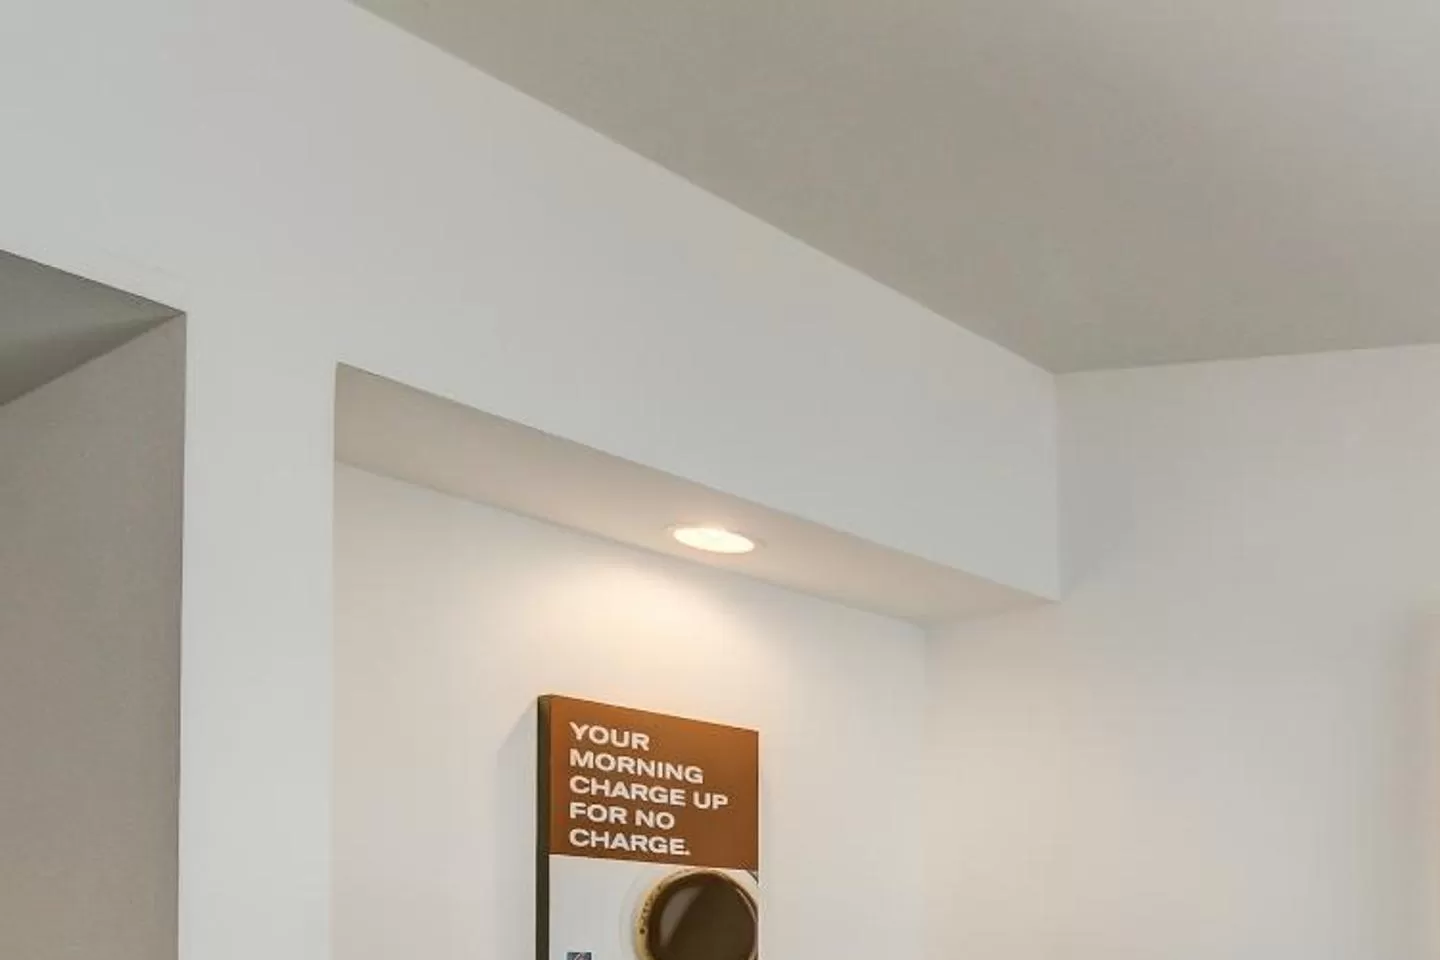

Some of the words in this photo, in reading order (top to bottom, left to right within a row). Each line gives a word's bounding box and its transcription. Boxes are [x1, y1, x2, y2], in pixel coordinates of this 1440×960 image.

[568, 721, 650, 751] YOUR
[568, 748, 704, 784] MORNING
[568, 775, 686, 807] CHARGE
[693, 792, 729, 809] UP
[568, 802, 628, 825] FOR
[634, 811, 676, 830] NO
[568, 828, 691, 856] CHARGE.
